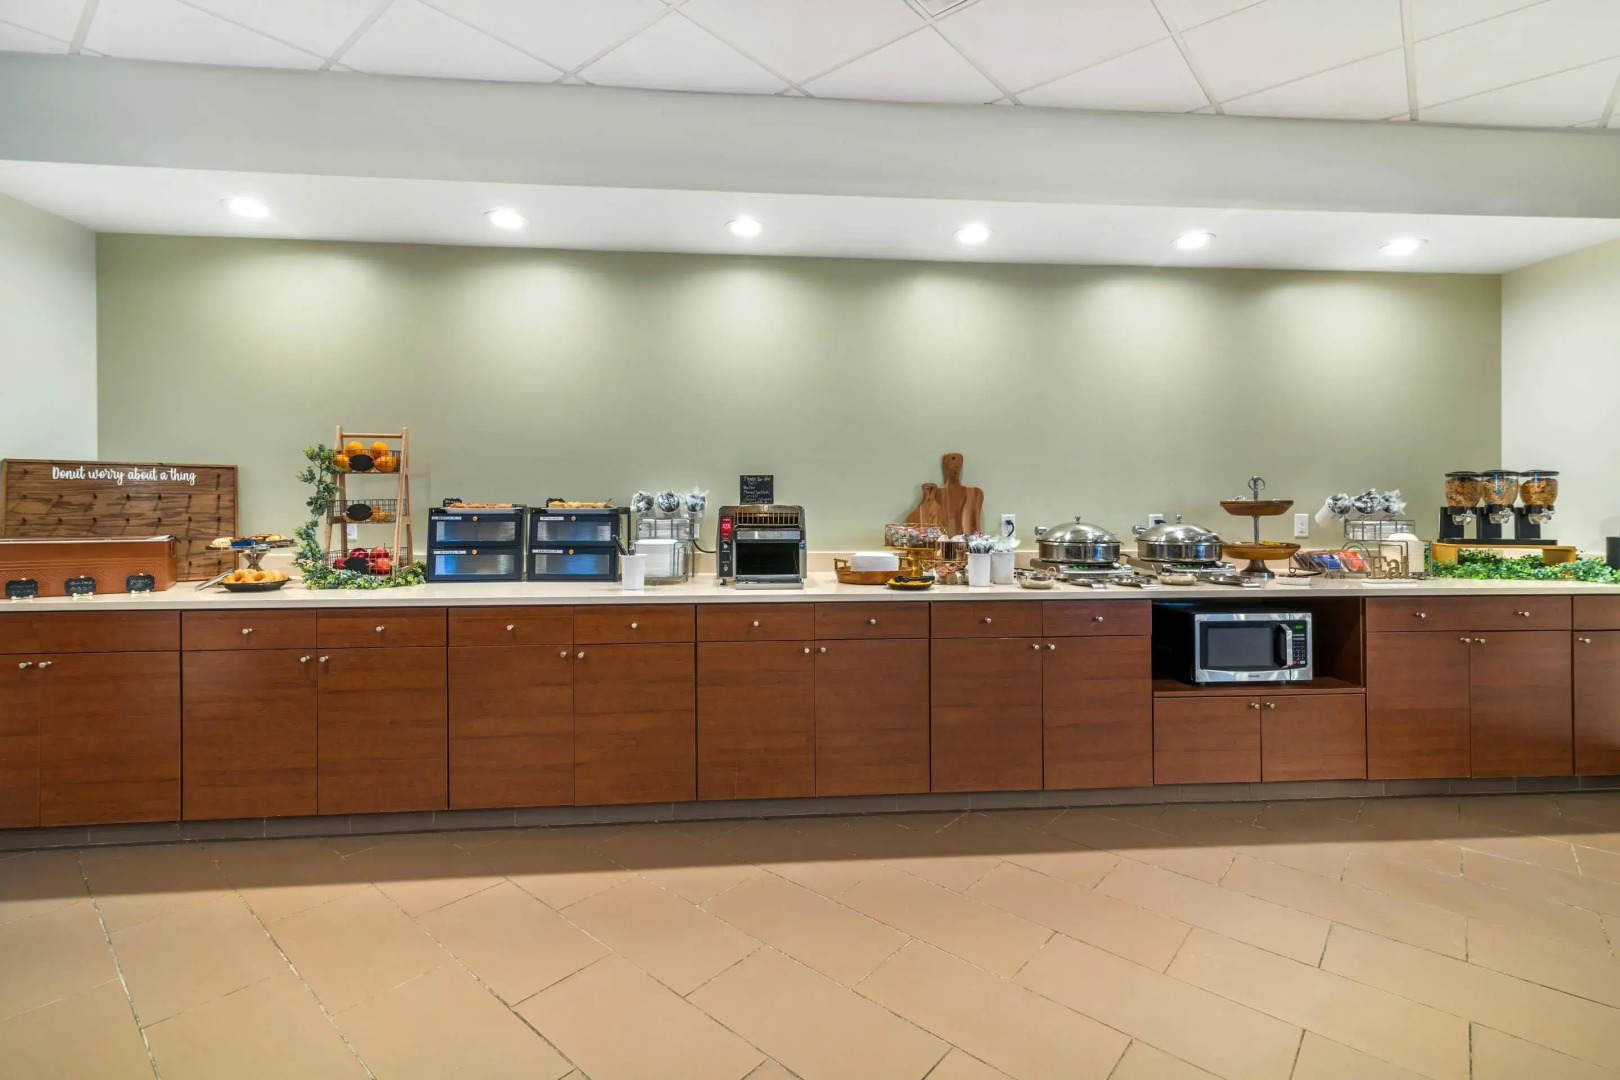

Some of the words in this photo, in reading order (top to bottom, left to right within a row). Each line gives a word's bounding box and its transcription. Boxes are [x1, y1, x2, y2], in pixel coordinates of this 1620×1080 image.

[52, 466, 85, 480] Donut
[88, 469, 125, 485] worry
[127, 467, 157, 481] about
[160, 471, 168, 481] a
[168, 468, 197, 486] thing
[1367, 555, 1409, 579] Eat
